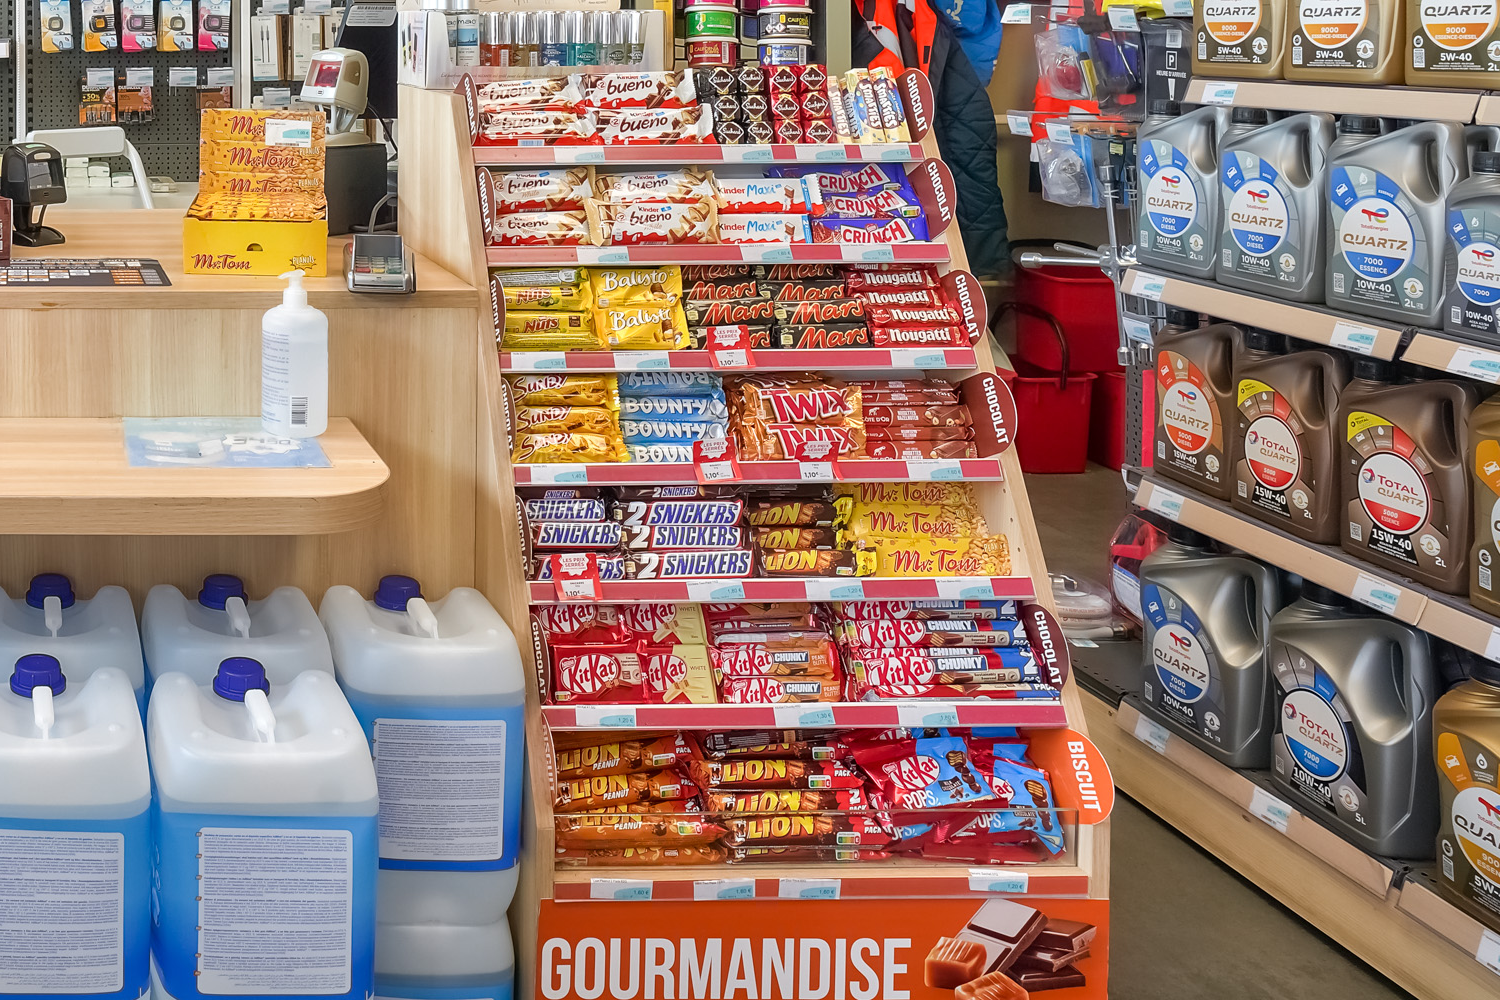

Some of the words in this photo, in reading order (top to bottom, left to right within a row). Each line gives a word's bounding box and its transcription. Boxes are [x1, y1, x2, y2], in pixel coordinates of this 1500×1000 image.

[1303, 6, 1362, 18] QUARTZ
[607, 75, 652, 95] bueno
[873, 82, 898, 129] SMARTIES
[907, 74, 929, 134] CHOCOLAT
[818, 164, 883, 192] CRUNCH
[718, 186, 745, 195] Kinder
[747, 184, 776, 198] Maxi
[629, 207, 672, 226] bueno
[1342, 233, 1408, 252] QUARTZ
[292, 254, 315, 266] PEANUTS
[1360, 264, 1388, 275] ESSENCE
[601, 269, 668, 292] Balisto
[1356, 279, 1392, 293] 10W-40
[792, 301, 865, 325] Mars
[890, 326, 951, 342] Nougatti
[626, 398, 708, 414] BOUNTY
[761, 388, 850, 423] TWIX
[982, 377, 1009, 444] CHOCOLAT
[1378, 476, 1418, 496] TOTAL
[624, 502, 647, 525] 2
[651, 504, 738, 524] SNICKERS
[541, 525, 620, 545] SNICKERS
[1372, 528, 1412, 551] 15W-40
[1033, 610, 1063, 686] CHOCOLAT
[564, 655, 617, 690] KitKat
[937, 658, 983, 670] CHUNKY
[1169, 681, 1188, 696] DIESEL
[593, 758, 620, 771] PEANUT
[722, 760, 786, 782] LION
[1067, 740, 1102, 812] BISCUIT
[903, 790, 934, 808] POPS
[540, 936, 911, 1000] GOURMANDISE
